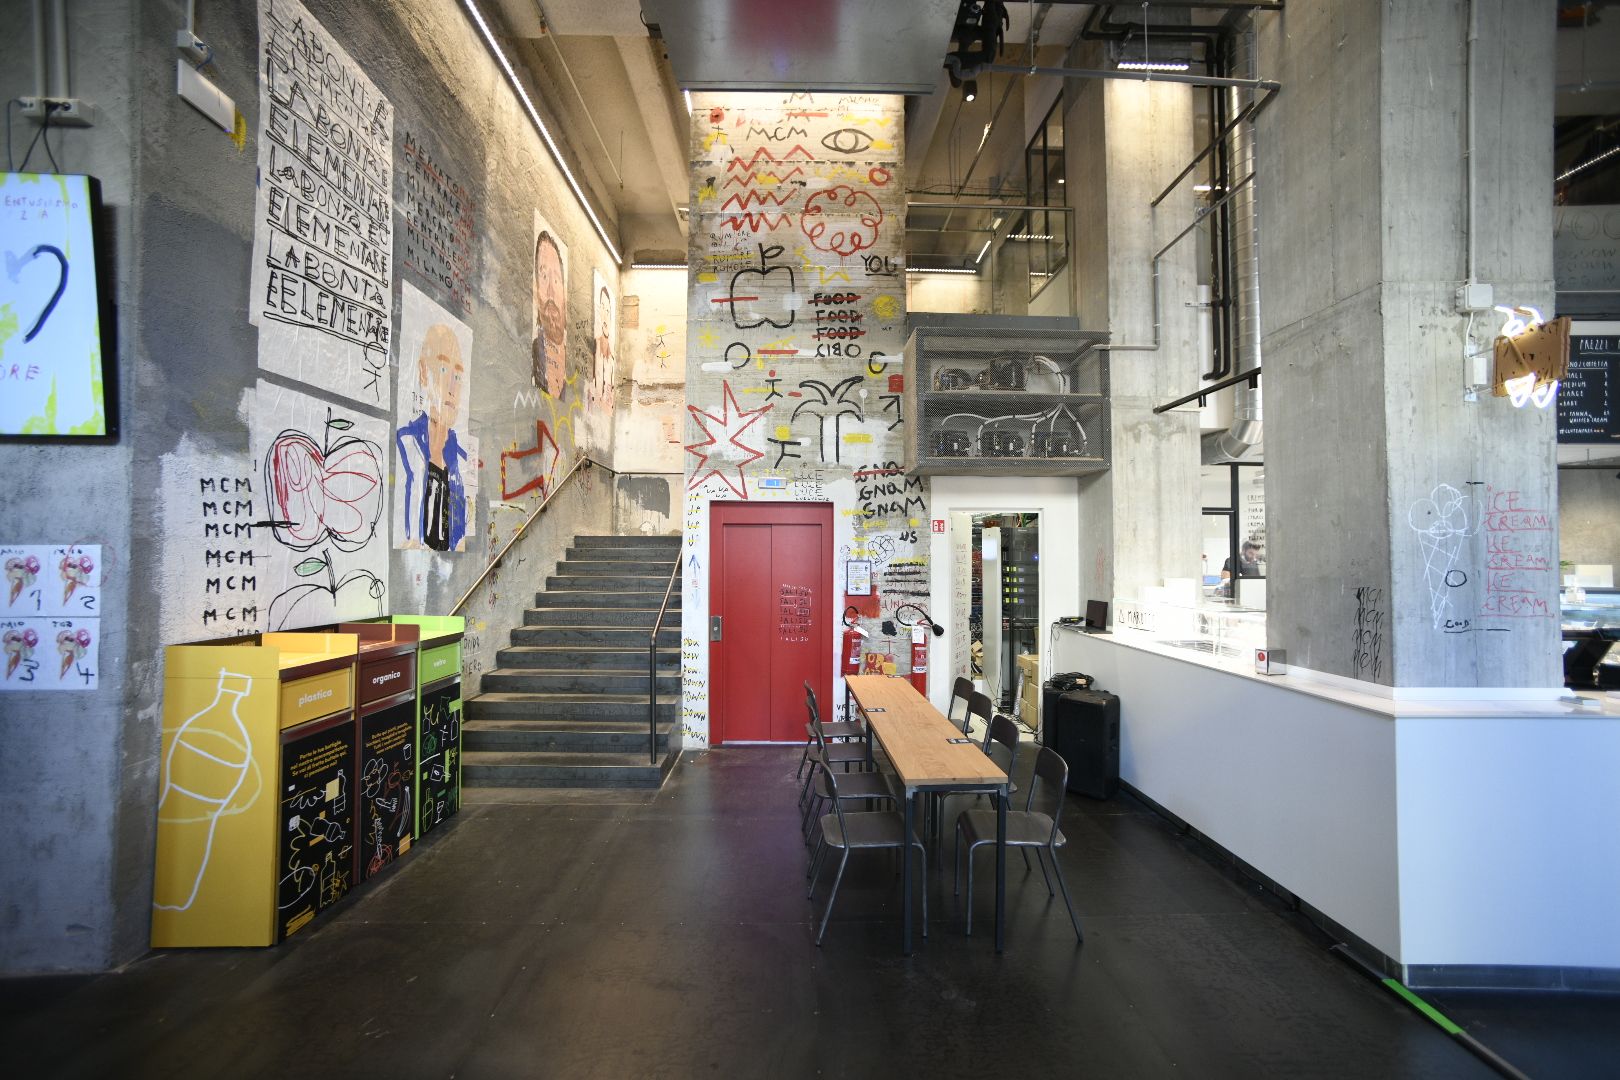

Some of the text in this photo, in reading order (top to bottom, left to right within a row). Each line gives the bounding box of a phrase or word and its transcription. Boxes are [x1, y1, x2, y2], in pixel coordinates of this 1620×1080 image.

[746, 126, 808, 142] MCM
[860, 255, 898, 273] YOU
[813, 293, 859, 306] FOOD
[816, 310, 862, 323] FOOD
[816, 327, 860, 341] FOOD
[200, 477, 252, 496] MCM
[203, 500, 252, 518] MCM
[205, 523, 251, 538] MCM
[206, 550, 252, 567] MCM
[206, 576, 256, 594] MCM
[80, 595, 96, 610] 2
[203, 606, 257, 627] MCM
[433, 659, 447, 668] vetro
[77, 662, 95, 685] 4
[372, 670, 401, 685] organico
[298, 689, 333, 707] plastica
